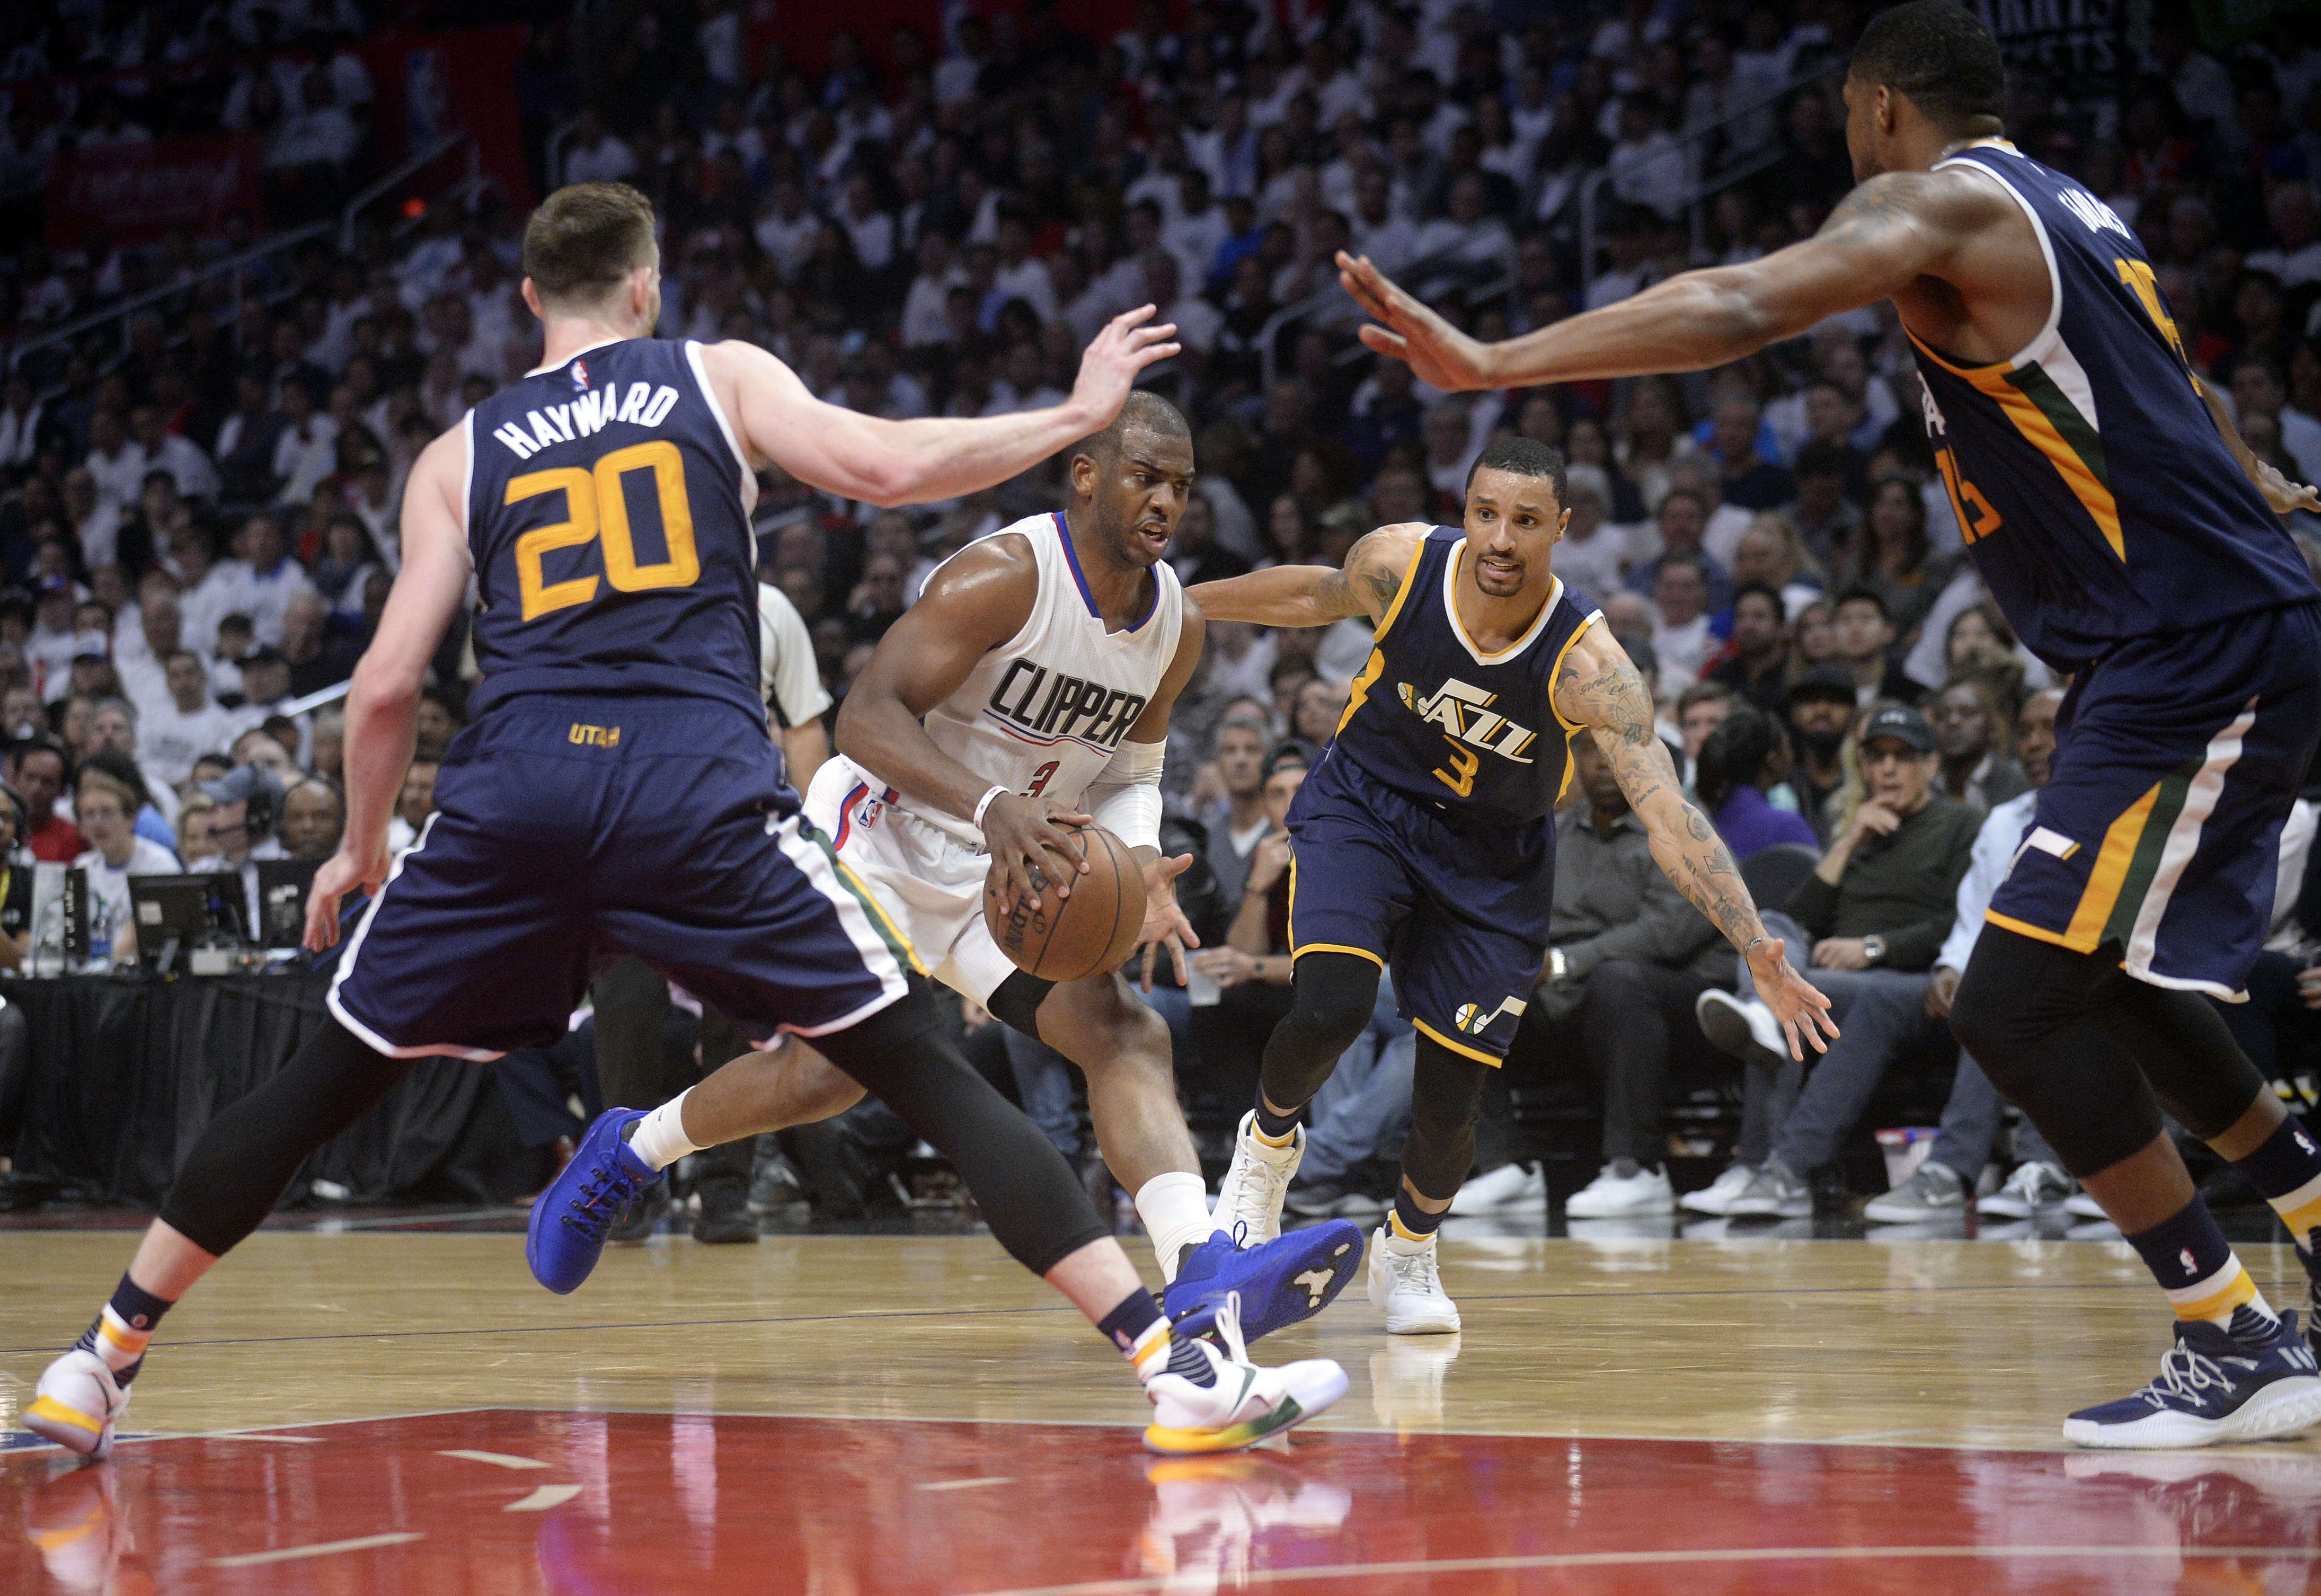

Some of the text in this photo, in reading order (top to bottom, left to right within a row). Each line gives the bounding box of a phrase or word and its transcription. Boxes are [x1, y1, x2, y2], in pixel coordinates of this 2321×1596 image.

[493, 382, 679, 460] HAYWARD
[504, 440, 701, 622] 20
[989, 658, 1146, 748] CLIPPER
[1397, 678, 1537, 764] JAZZ
[1432, 734, 1479, 797] 3
